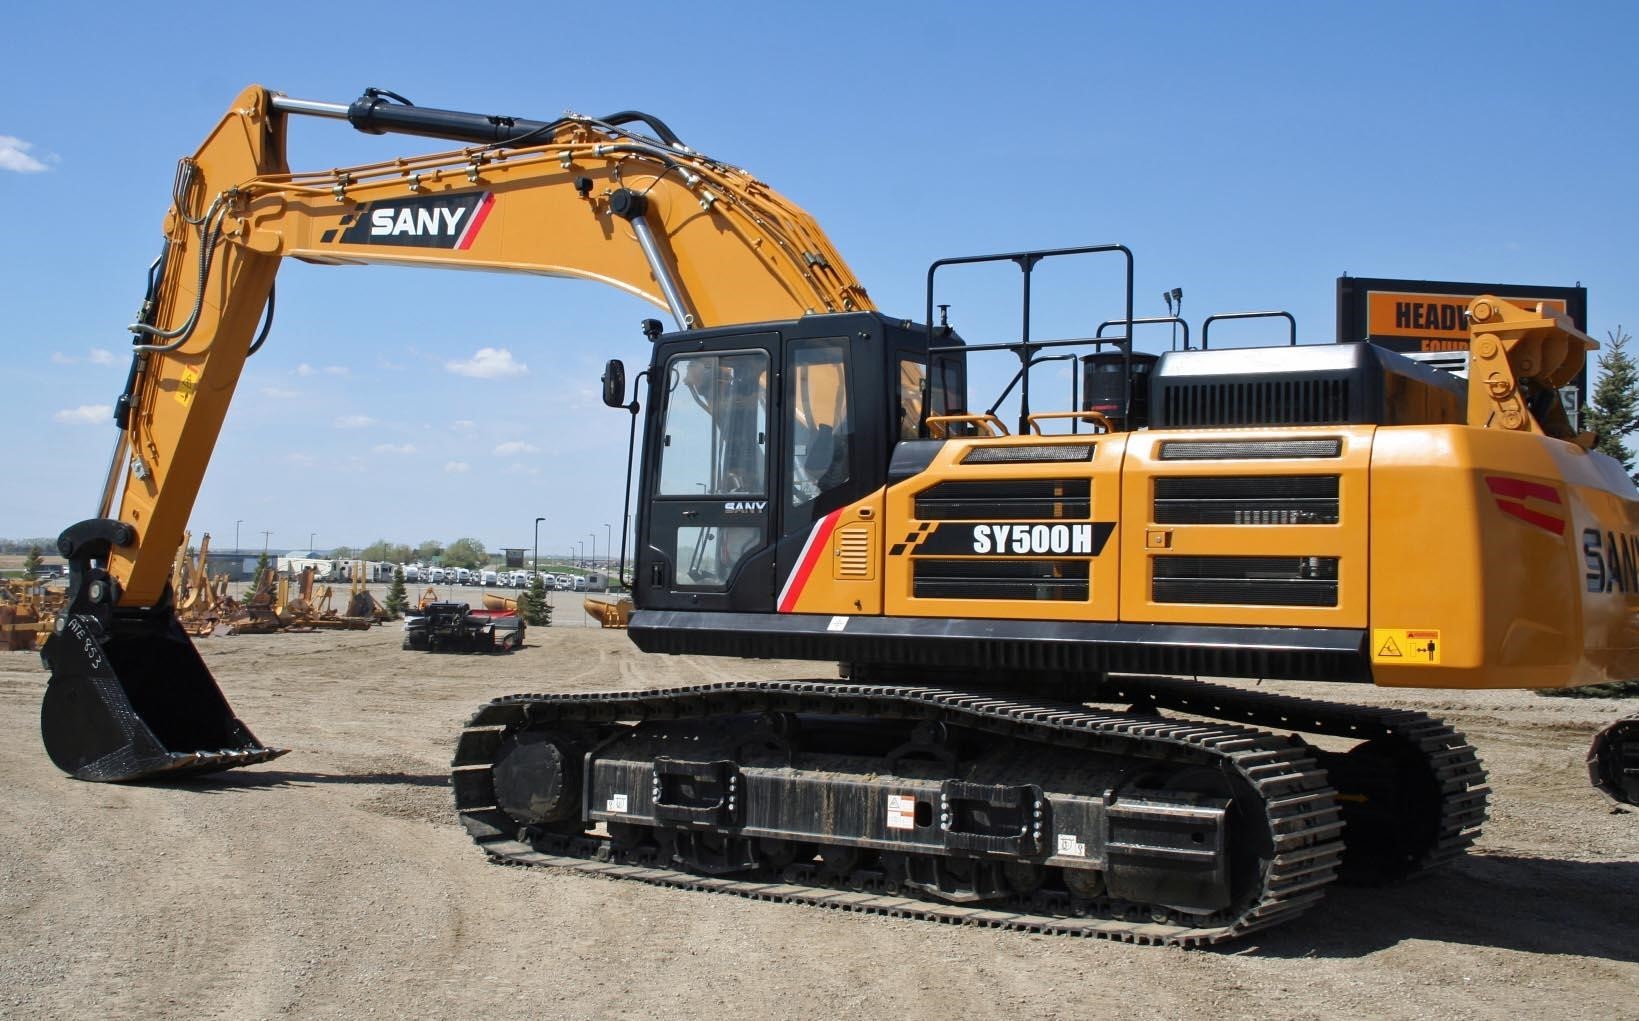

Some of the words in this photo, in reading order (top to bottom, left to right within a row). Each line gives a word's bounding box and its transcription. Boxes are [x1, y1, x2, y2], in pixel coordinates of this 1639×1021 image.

[371, 207, 466, 236] SANY
[724, 501, 767, 514] SANY
[973, 524, 1092, 554] SY500H
[1583, 527, 1639, 593] SAN
[68, 618, 87, 640] ATE
[84, 637, 102, 669] 853
